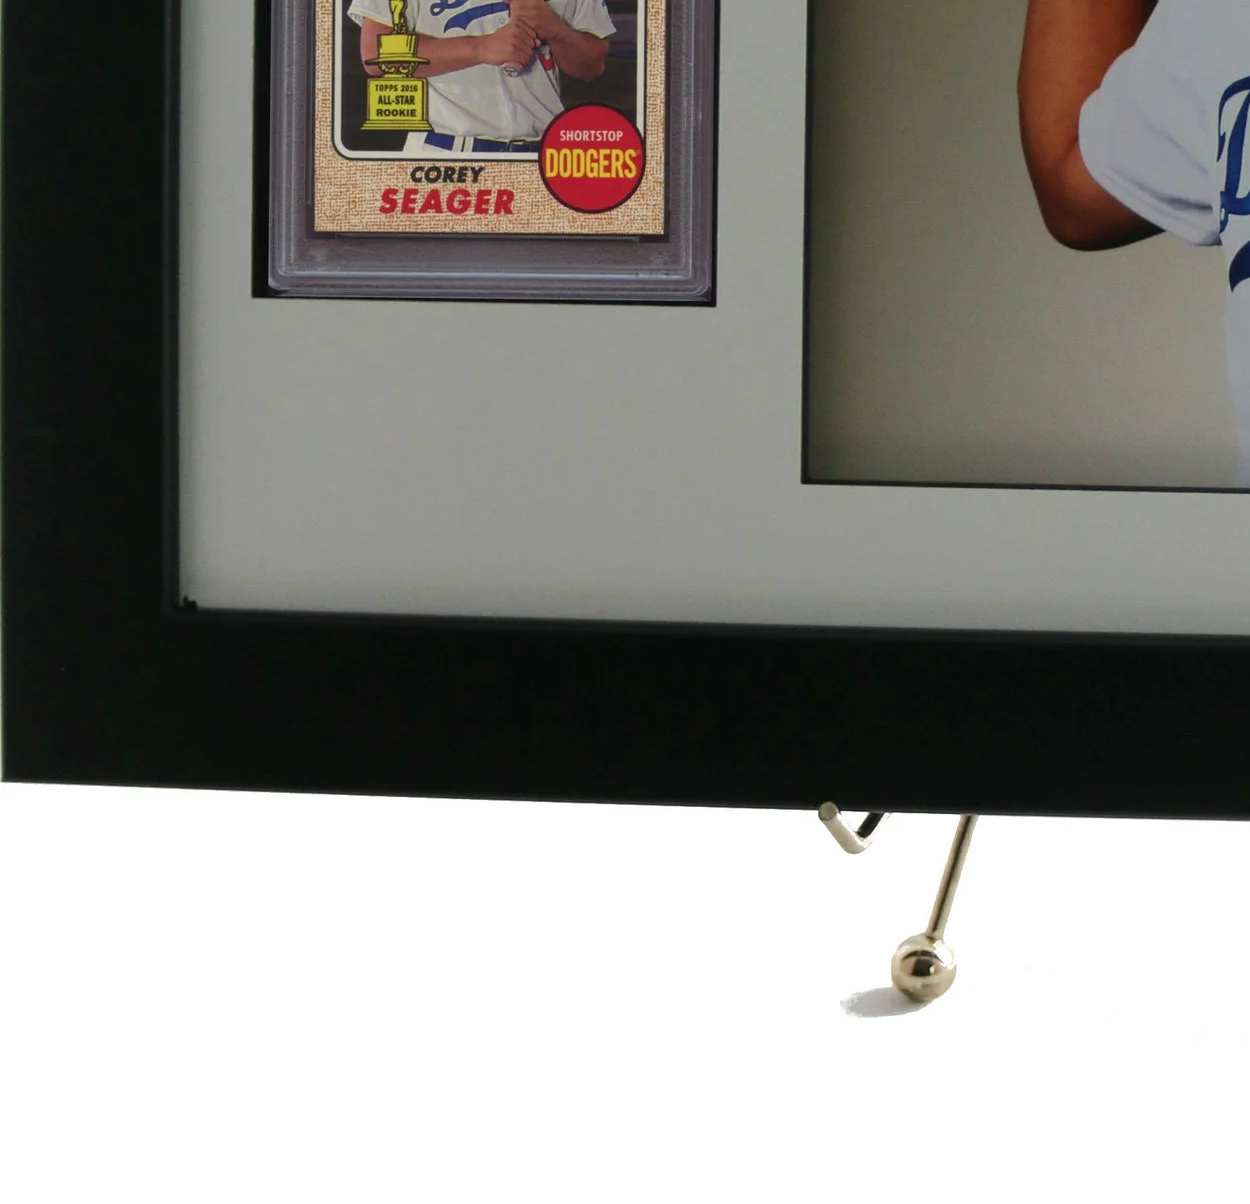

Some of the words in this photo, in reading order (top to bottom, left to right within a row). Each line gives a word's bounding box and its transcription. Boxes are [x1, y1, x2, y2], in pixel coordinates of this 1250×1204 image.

[375, 84, 398, 93] TOPPS
[400, 84, 418, 93] 2016
[377, 95, 416, 106] ALL-STAR
[376, 108, 417, 117] ROOKIE
[559, 129, 624, 142] SHORTSTOP
[545, 147, 638, 179] DODGERS
[410, 165, 485, 184] COREY
[378, 188, 516, 216] SEAGER
